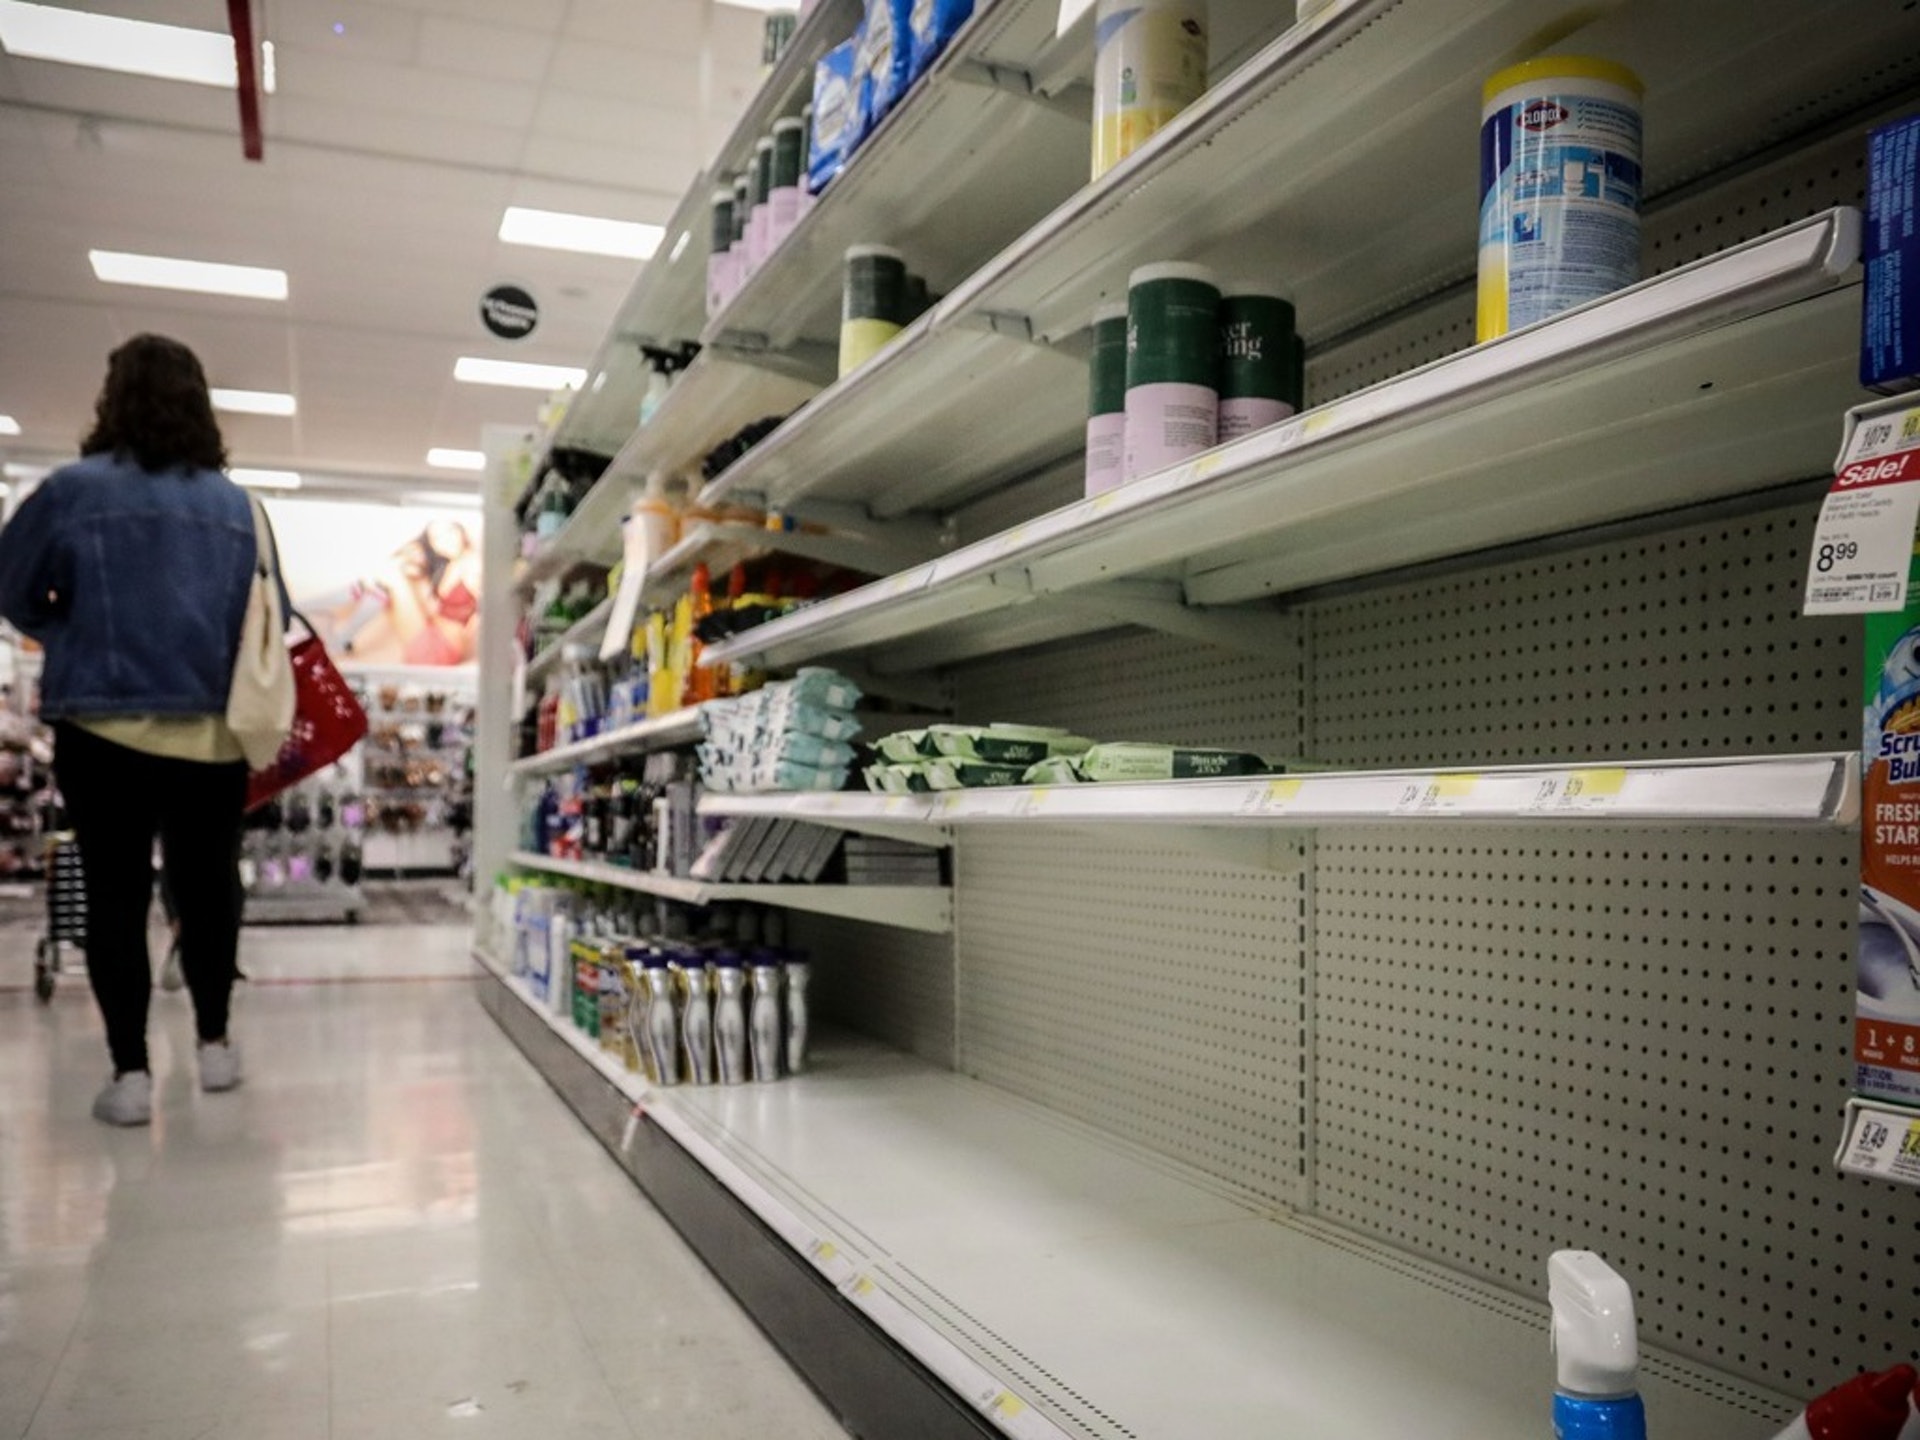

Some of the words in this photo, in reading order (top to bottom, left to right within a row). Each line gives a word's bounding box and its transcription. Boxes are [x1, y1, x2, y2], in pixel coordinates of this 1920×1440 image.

[1839, 455, 1910, 487] Sale!
[1875, 803, 1920, 823] FRESH
[1875, 825, 1920, 845] STAR
[1904, 1035, 1914, 1053] 8
[1860, 1122, 1888, 1149] 9.49
